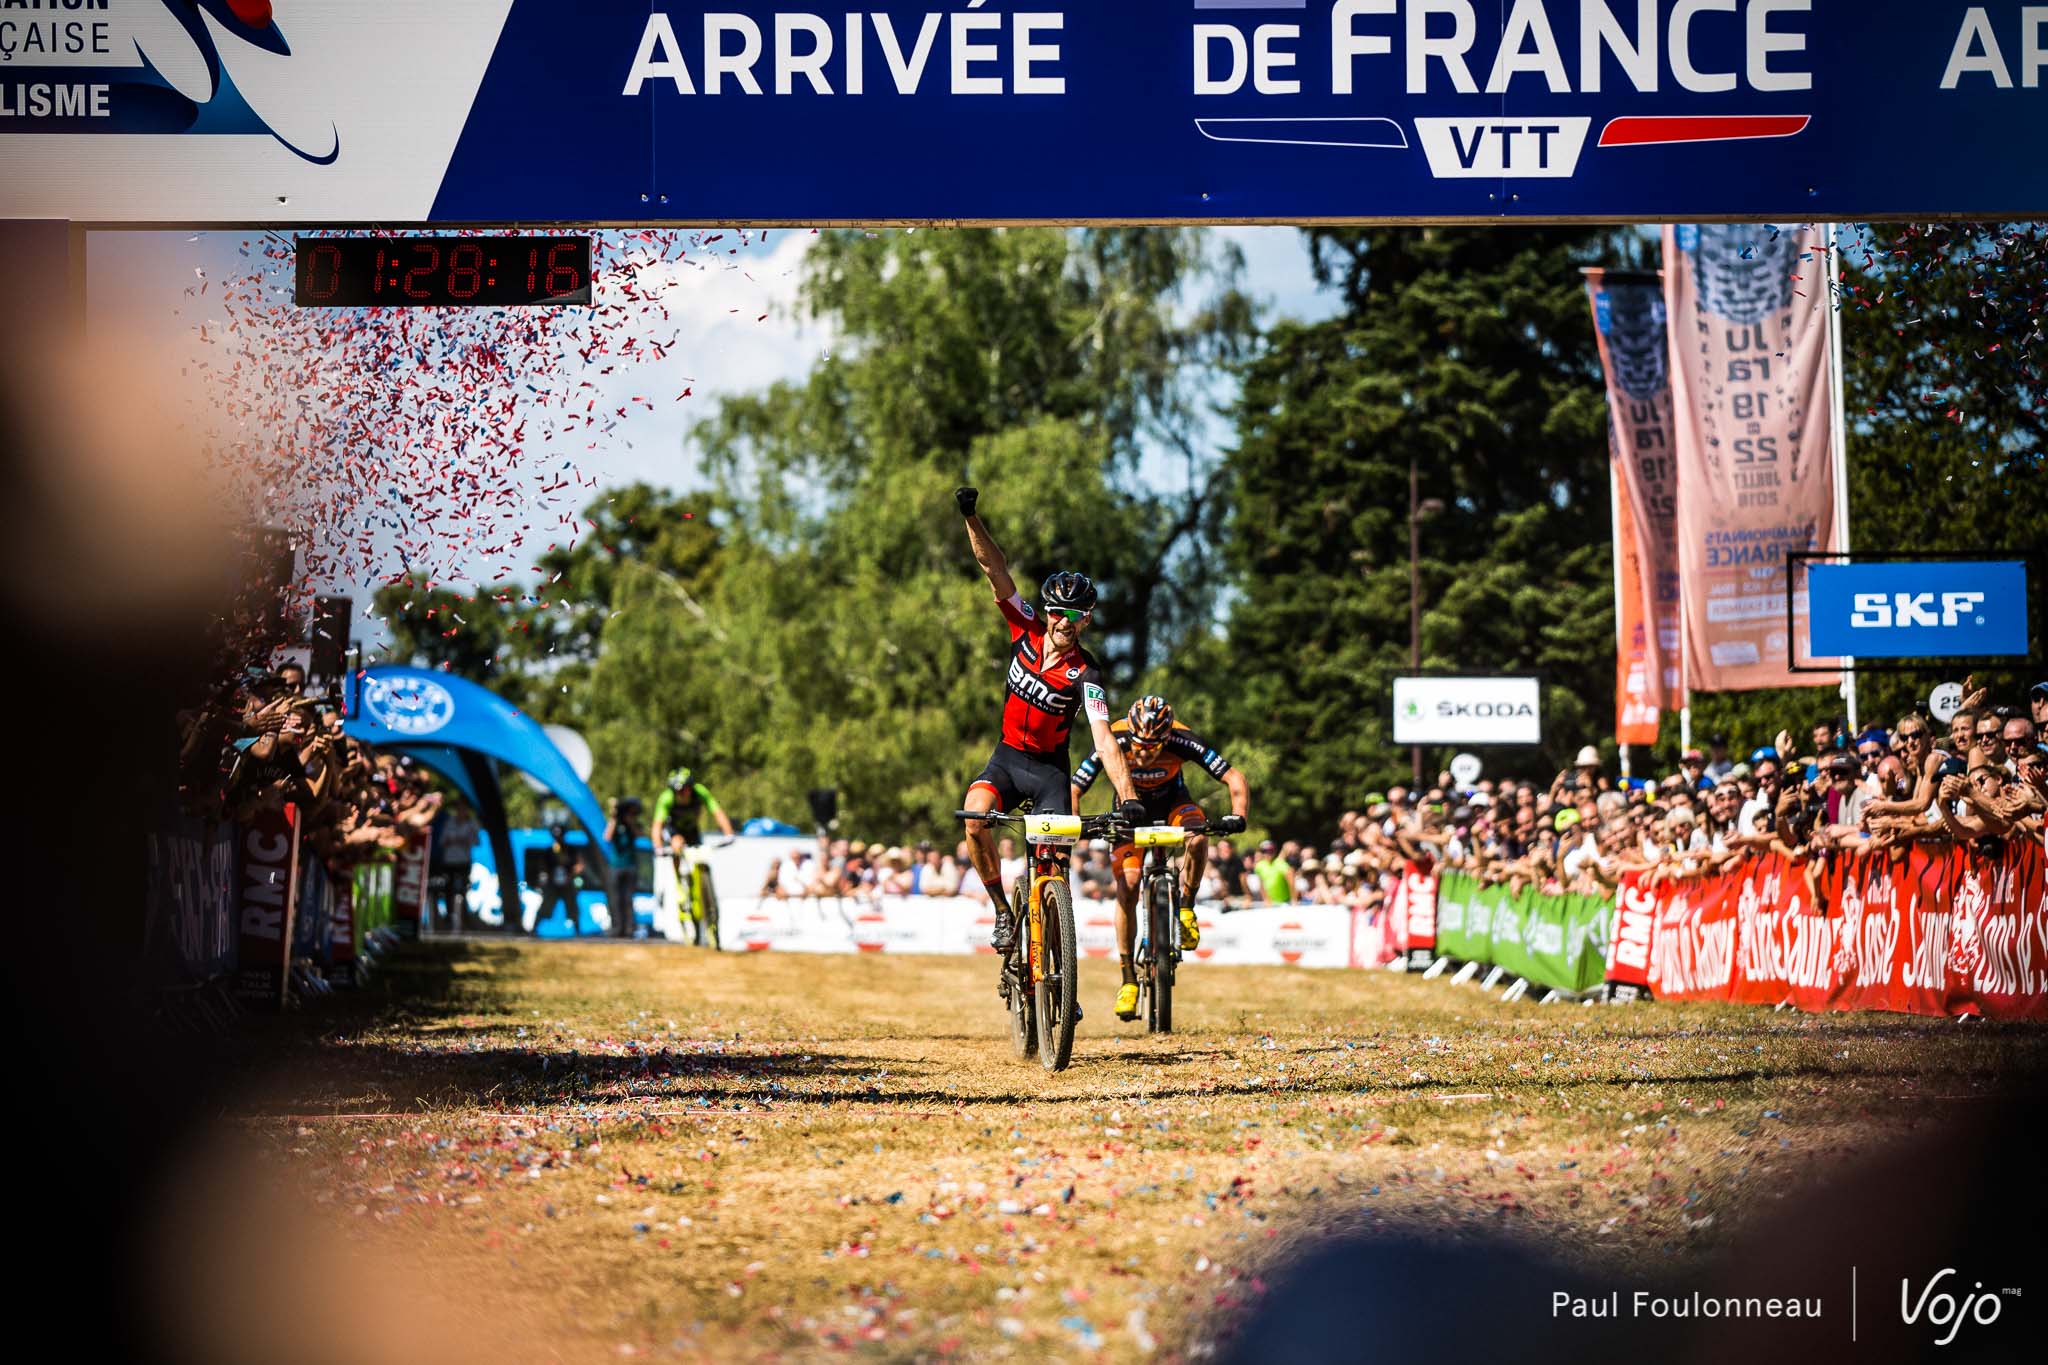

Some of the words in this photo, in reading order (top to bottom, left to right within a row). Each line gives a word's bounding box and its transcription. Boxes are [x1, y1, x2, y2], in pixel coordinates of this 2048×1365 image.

[0, 21, 110, 60] ÇAISE
[622, 0, 1065, 95] ARRIVÉE
[1194, 24, 1302, 95] DE
[1332, 0, 1813, 94] FRANCE
[1449, 125, 1560, 169] VTT
[1041, 821, 1051, 832] 3
[241, 829, 288, 943] RMC
[1407, 872, 1436, 938] RMC
[1615, 886, 1656, 970] RMC
